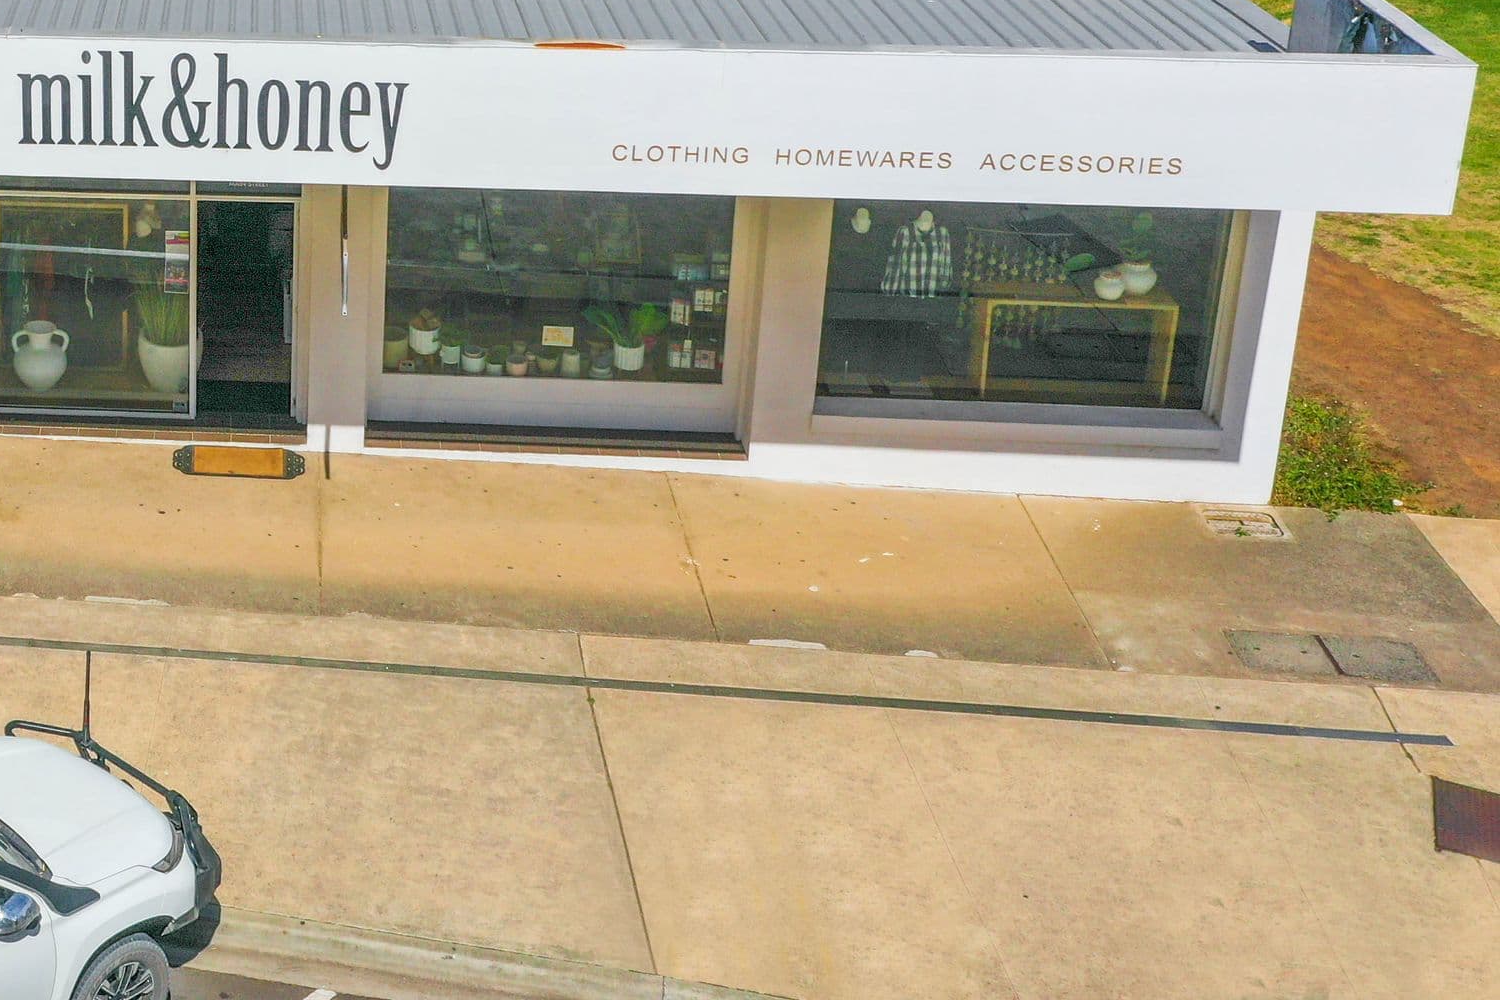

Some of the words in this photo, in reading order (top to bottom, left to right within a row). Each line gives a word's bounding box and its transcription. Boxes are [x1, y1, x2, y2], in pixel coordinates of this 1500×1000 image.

[16, 50, 410, 171] milk&honey
[611, 144, 750, 164] CLOTHING
[775, 147, 953, 169] HOMEWARES
[979, 153, 1184, 176] ACCESSORIES
